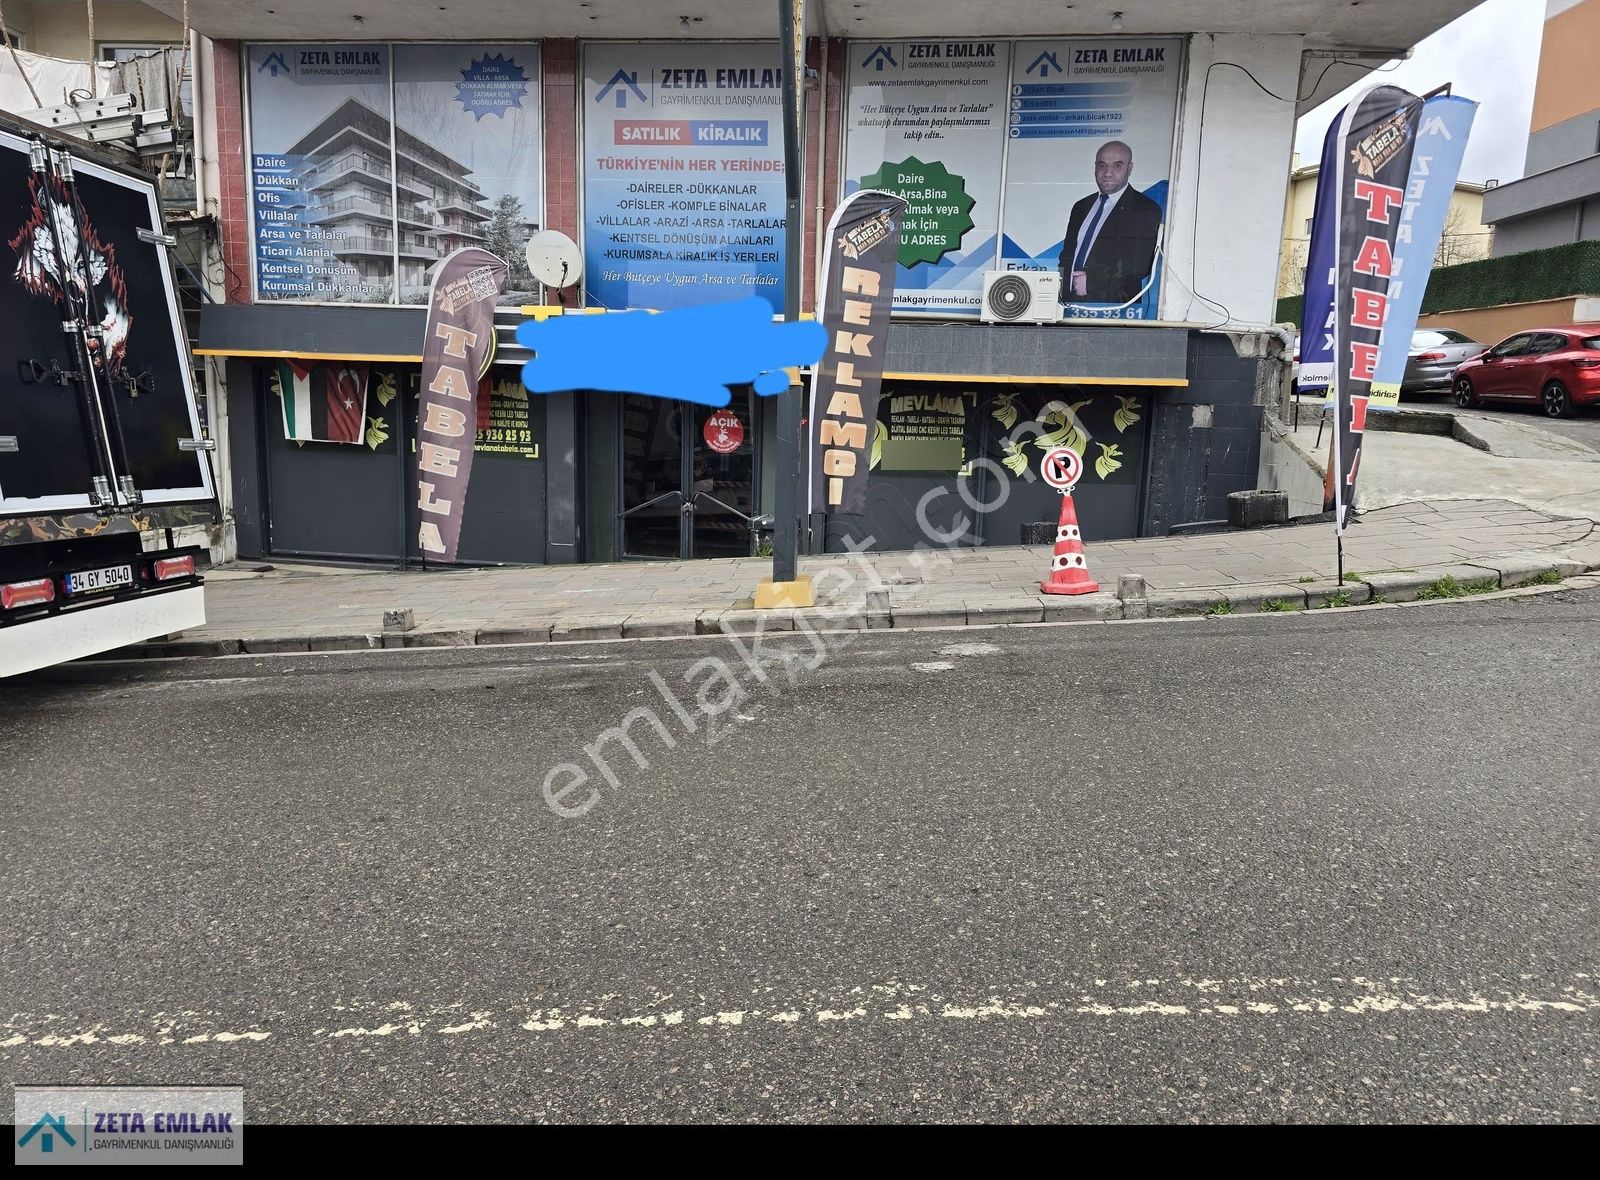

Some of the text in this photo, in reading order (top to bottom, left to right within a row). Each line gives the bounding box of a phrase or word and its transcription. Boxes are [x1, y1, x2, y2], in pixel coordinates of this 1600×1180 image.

[909, 43, 995, 58] ZETA EMLAK
[1075, 48, 1165, 63] ZETA EMLAK
[300, 51, 380, 65] ZETA EMLAK
[660, 68, 709, 89] ZETA
[868, 78, 988, 88] www.zetaemlakgayrimenkul.com
[660, 94, 783, 108] GAYRİMENKUL DANIŞMANLI
[907, 104, 930, 116] Uygun
[930, 104, 947, 113] Arsa
[857, 118, 891, 128] whatsapp
[892, 117, 930, 126] durumdan
[622, 126, 681, 141] SATILIK
[698, 123, 762, 142] KİRALIK
[904, 131, 923, 141] takip
[1365, 126, 1400, 160] TABELA
[256, 157, 286, 168] Daire
[688, 159, 717, 172] HER
[722, 157, 785, 174] YERİNDE;
[257, 175, 299, 186] Dükkan
[897, 173, 925, 184] Daire
[258, 192, 281, 203] Ofis
[668, 201, 716, 212] -KOMPLE
[719, 199, 767, 212] BİNALAR
[935, 206, 959, 216] veya
[258, 210, 299, 221] Villalar
[692, 218, 725, 228] -ARSA
[920, 217, 938, 231] İçin
[259, 228, 347, 240] Arsa ve Tarlalar
[609, 232, 774, 246] -KENTSEL DÖNÜŞÜM ALANLARI
[852, 222, 884, 246] TABELA
[911, 235, 947, 246] ADRES
[260, 246, 335, 258] Ticari Alanlar
[675, 249, 717, 262] KİRALIK
[720, 249, 730, 264] İŞ
[733, 250, 779, 263] YERLERİ
[261, 263, 303, 275] Kentsel
[602, 271, 622, 282] Her
[664, 272, 697, 287] Uygun
[698, 273, 723, 285] Arsa
[726, 276, 737, 285] ve
[739, 273, 781, 286] Tarlalar
[262, 280, 374, 294] Kurumsal Dükkanlar
[1125, 307, 1143, 320] 61
[710, 417, 739, 429] AÇIK
[418, 322, 477, 554] TABELA
[485, 429, 503, 441] 936
[505, 429, 517, 441] 25
[519, 430, 532, 442] 93
[949, 427, 964, 436] TABELA
[1053, 456, 1071, 479] P
[71, 567, 129, 590] 34 GY 5040
